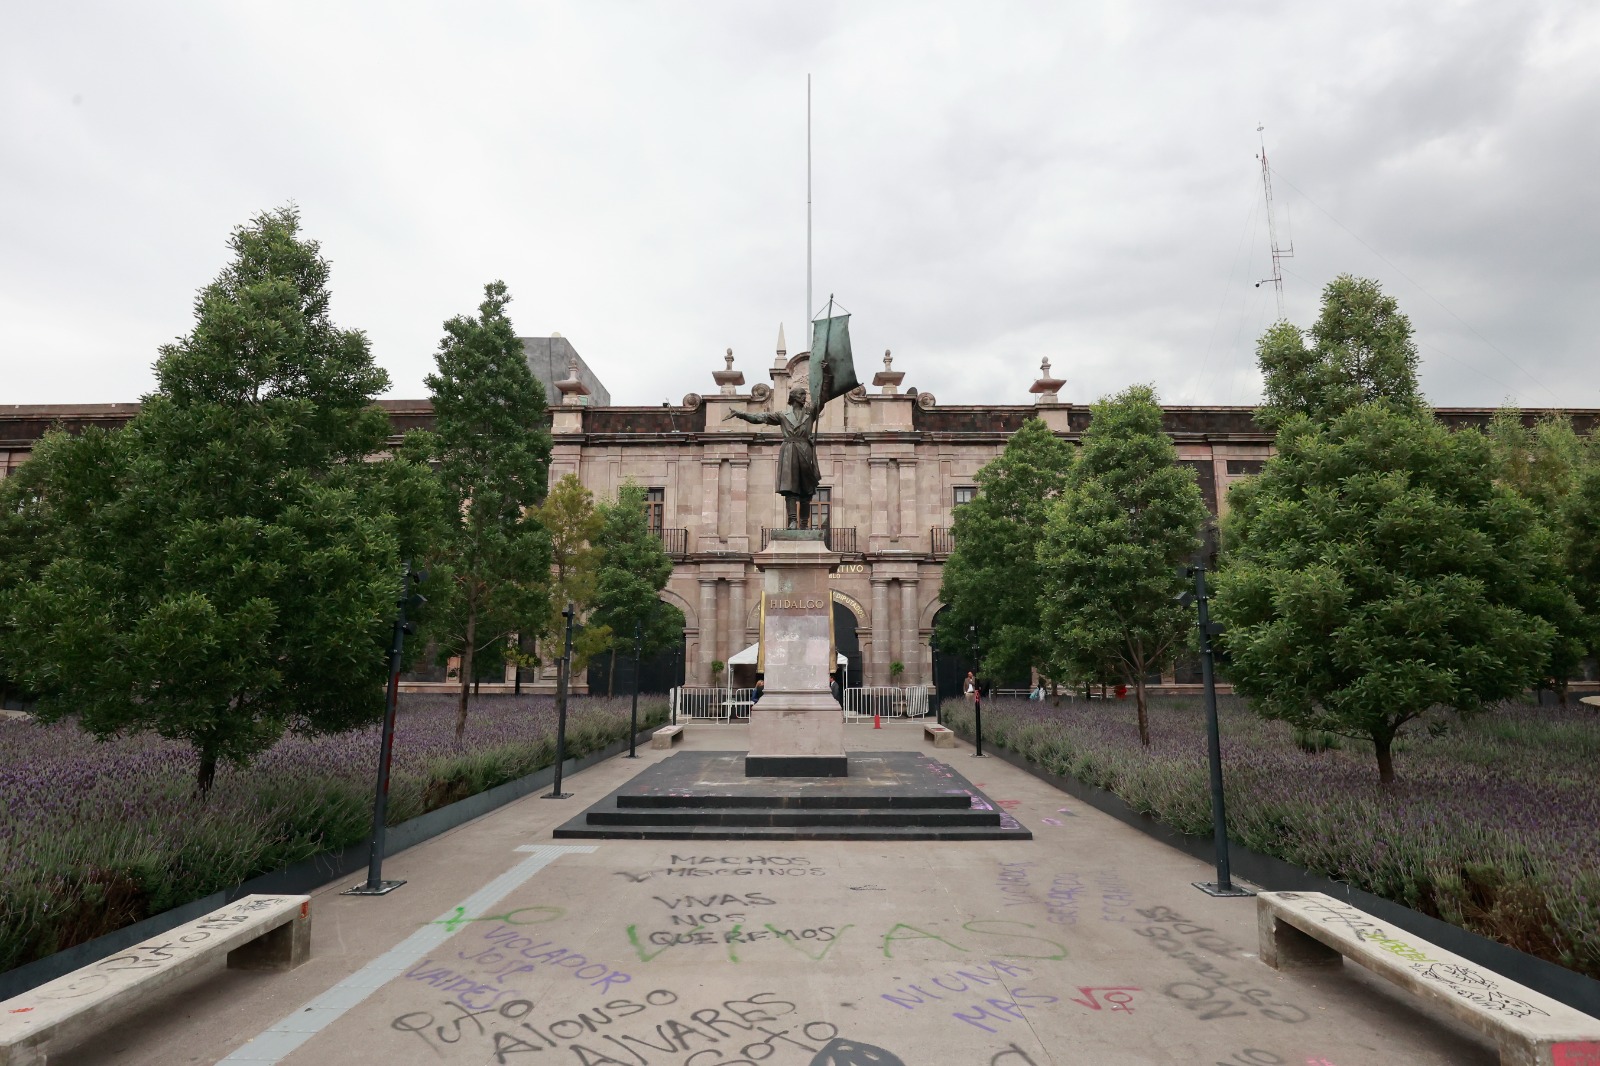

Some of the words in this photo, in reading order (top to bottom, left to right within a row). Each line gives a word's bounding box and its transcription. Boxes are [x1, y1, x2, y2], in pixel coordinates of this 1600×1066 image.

[770, 599, 824, 609] HIDALGO
[671, 855, 811, 866] MACHOS
[653, 893, 777, 909] VIVAS
[671, 913, 747, 927] NOS
[649, 926, 836, 947] QUEREMOS
[484, 926, 631, 995] VIOLADOR
[952, 988, 1058, 1033] MAS
